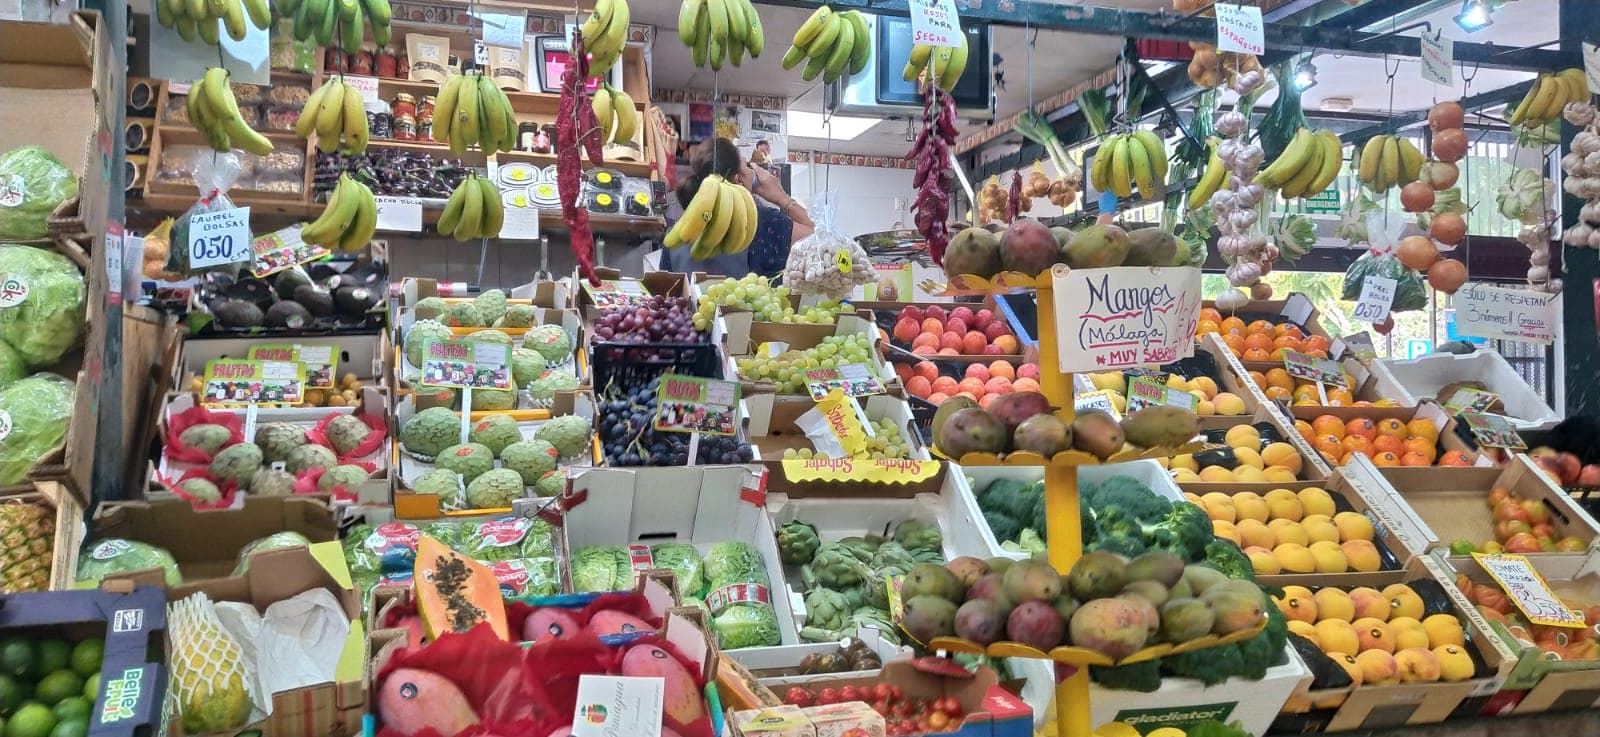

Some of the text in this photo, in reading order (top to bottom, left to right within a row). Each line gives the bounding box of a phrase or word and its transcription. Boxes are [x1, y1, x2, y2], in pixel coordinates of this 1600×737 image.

[929, 18, 952, 31] PARA
[191, 213, 235, 224] LAUREL
[203, 221, 245, 231] BOLSAS
[1085, 273, 1176, 328] Mangos
[1489, 291, 1500, 303] SE
[1504, 292, 1546, 307] RESPETAN
[430, 343, 468, 359] FRUTAS
[1109, 349, 1138, 362] MUY
[213, 363, 256, 378] FRUTAS
[827, 404, 849, 439] Sabater
[804, 456, 921, 475] Sabater Sabater
[1440, 576, 1488, 631] La Calandina
[122, 668, 143, 708] Belle
[1124, 710, 1223, 725] gladiator
